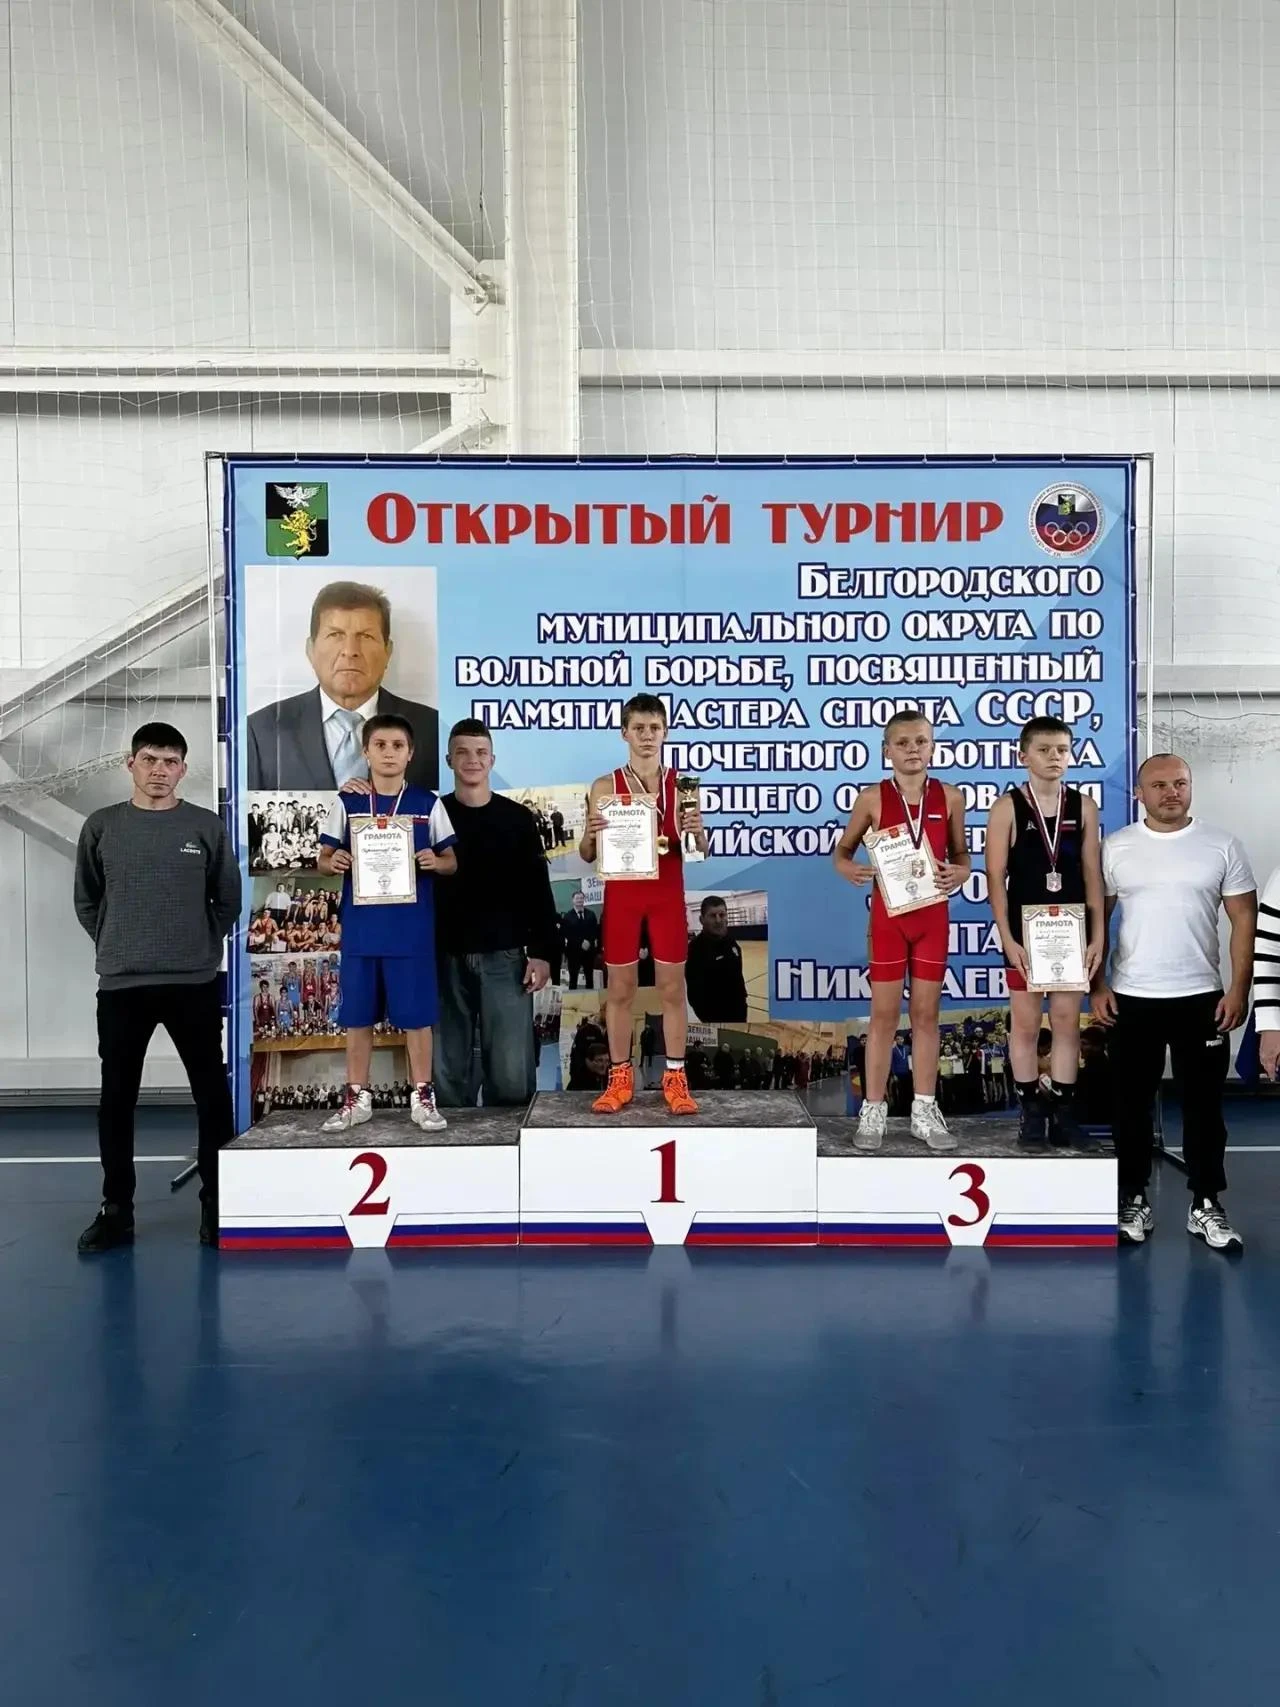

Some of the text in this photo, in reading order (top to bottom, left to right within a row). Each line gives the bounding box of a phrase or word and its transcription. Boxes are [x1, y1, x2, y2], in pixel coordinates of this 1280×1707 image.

[902, 609, 1036, 642] ОКРУГА
[1049, 608, 1104, 641] ПО
[456, 648, 632, 687] ВОЛЬНОЙ
[882, 737, 1106, 770] БОТНА
[608, 809, 646, 817] ГРАМОТА
[699, 782, 822, 819] БЩЕГО
[364, 832, 402, 841] ГРАМОТА
[880, 838, 912, 853] ГРАМОТ
[1036, 920, 1074, 928] ГРАМОТА
[349, 1152, 391, 1216] 2
[650, 1139, 685, 1203] 1
[947, 1163, 990, 1226] 3
